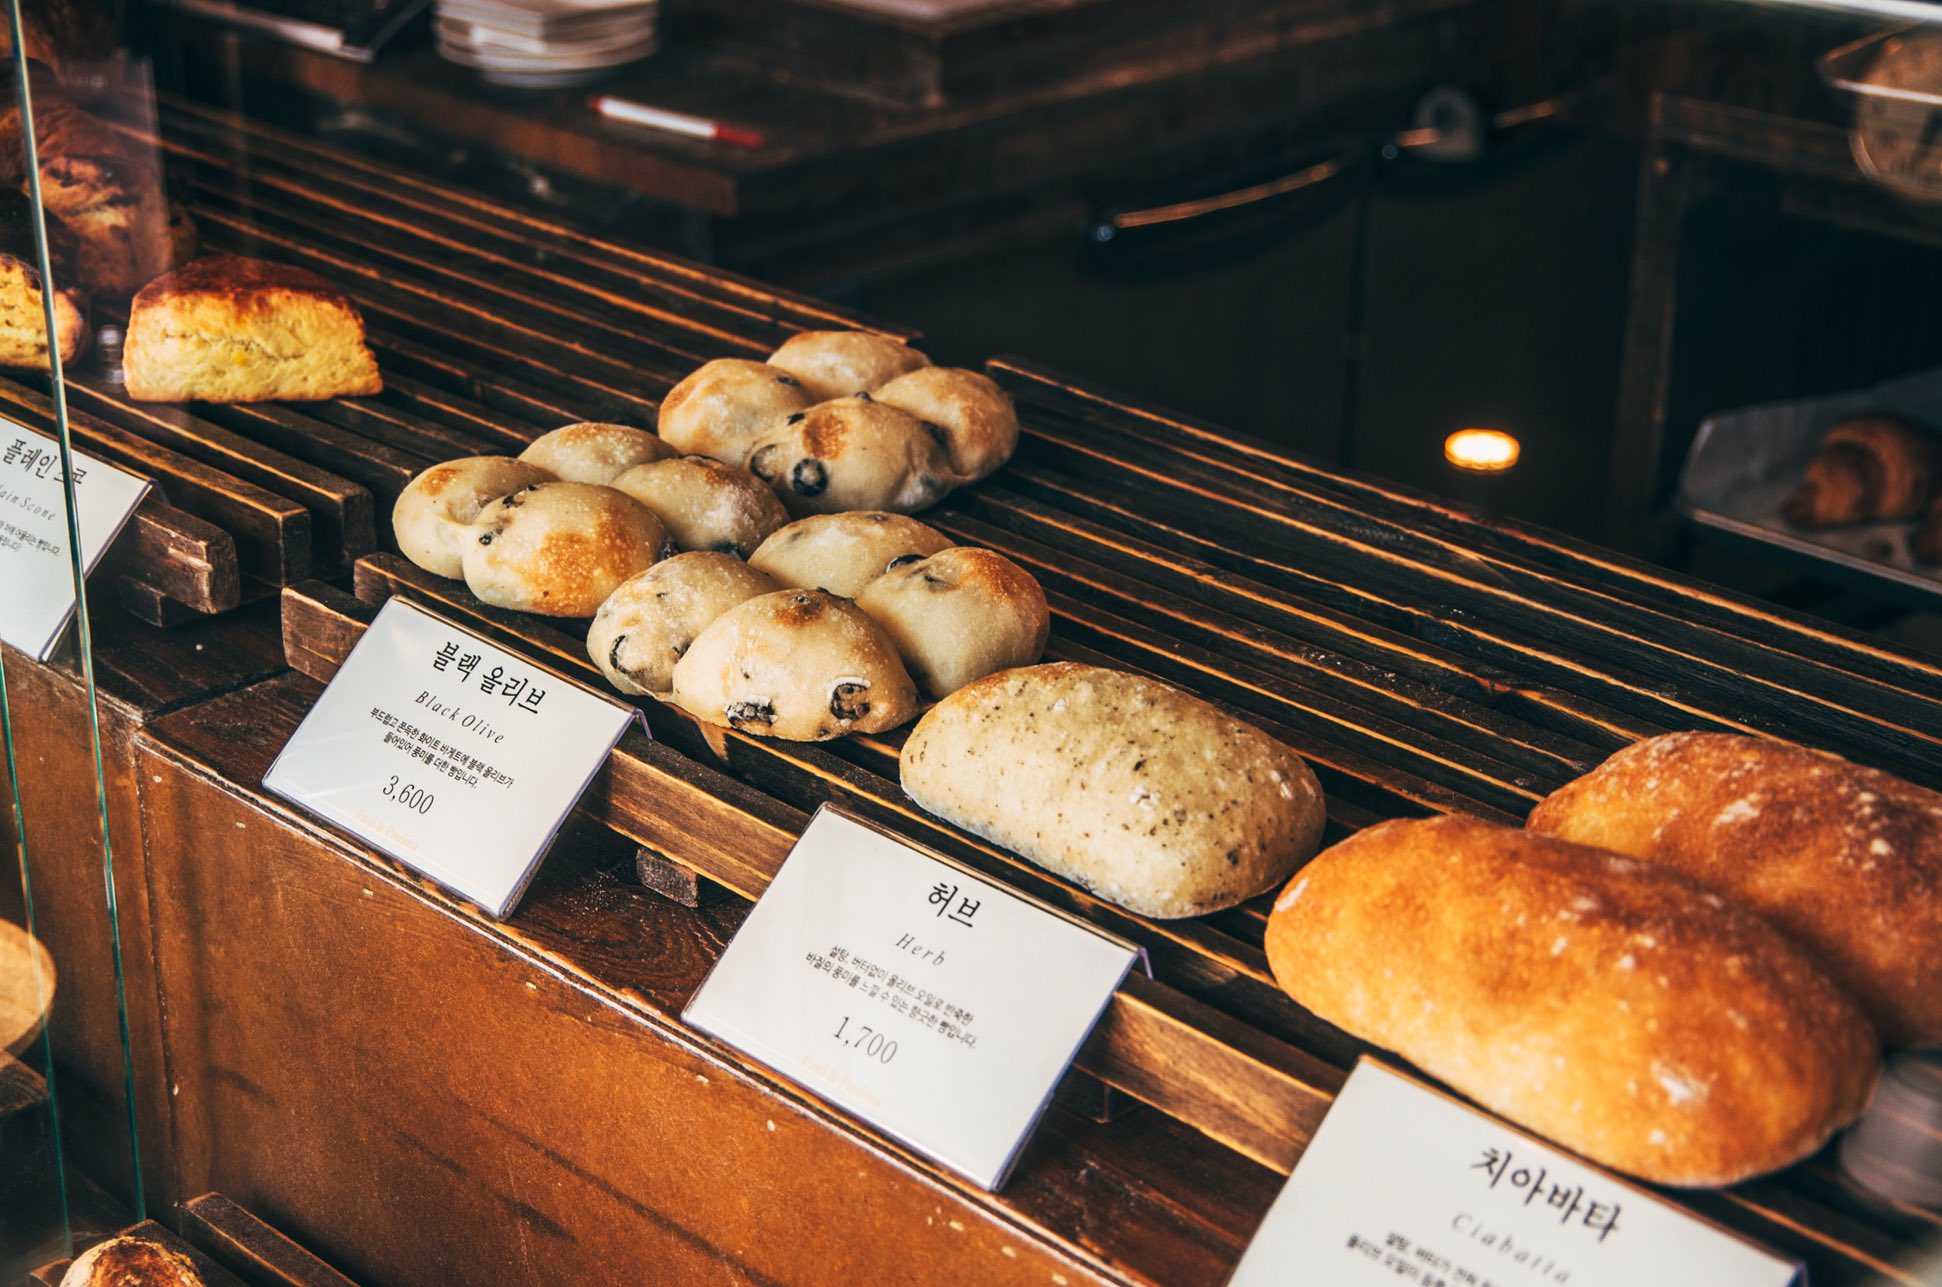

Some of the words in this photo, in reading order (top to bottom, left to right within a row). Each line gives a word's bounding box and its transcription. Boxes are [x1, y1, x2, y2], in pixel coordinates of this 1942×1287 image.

[4, 439, 57, 479] 플레인
[20, 497, 56, 521] Scone
[433, 642, 482, 683] 블랙
[480, 666, 546, 715] 올리브
[415, 691, 461, 722] Black
[461, 714, 504, 744] Olive
[371, 708, 399, 728] 부드럽고
[418, 732, 441, 751] 화이트
[440, 743, 470, 765] 바게트에
[467, 758, 486, 774] 블랙
[483, 766, 515, 789] 올리브가
[384, 732, 414, 754] 들어있어
[411, 746, 436, 765] 풍미를
[433, 757, 450, 773] 더한
[383, 775, 435, 815] 3,600
[928, 883, 981, 928] 허브
[895, 933, 945, 967] Herb
[806, 951, 834, 974] 바질의
[831, 966, 861, 989] 풍미를
[859, 980, 881, 999] 느낄
[880, 990, 892, 1002] 수
[889, 995, 910, 1014] 있는
[909, 1004, 939, 1029] 향긋한
[852, 956, 888, 981] 버터없이
[887, 974, 916, 996] 올리브
[916, 988, 944, 1010] 오일로
[945, 1002, 974, 1026] 반죽한
[833, 1016, 899, 1064] 1,700
[1470, 1147, 1621, 1243] 치아바타
